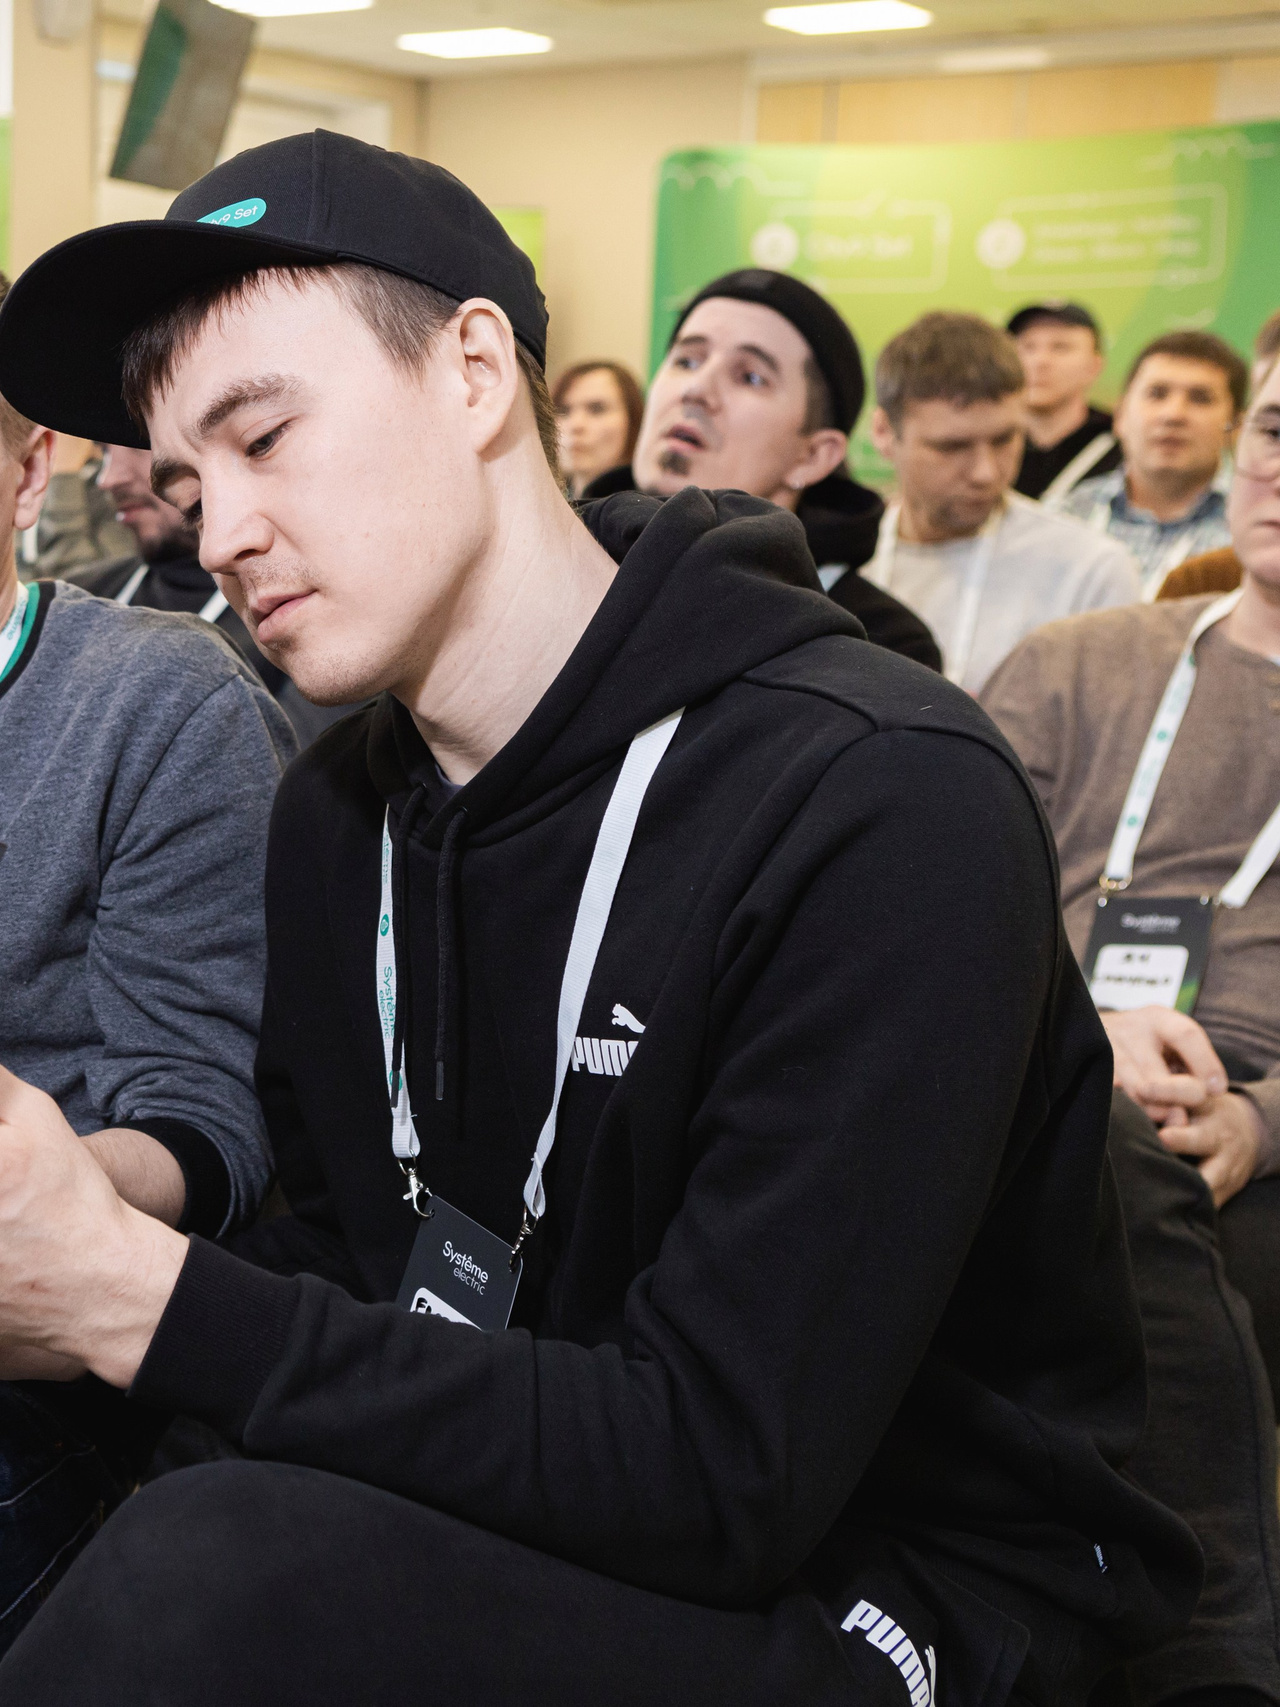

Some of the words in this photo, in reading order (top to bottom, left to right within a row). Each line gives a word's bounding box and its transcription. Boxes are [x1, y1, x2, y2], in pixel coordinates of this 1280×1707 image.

[234, 205, 258, 219] Set
[442, 1240, 489, 1283] Systême
[453, 1267, 486, 1295] electric
